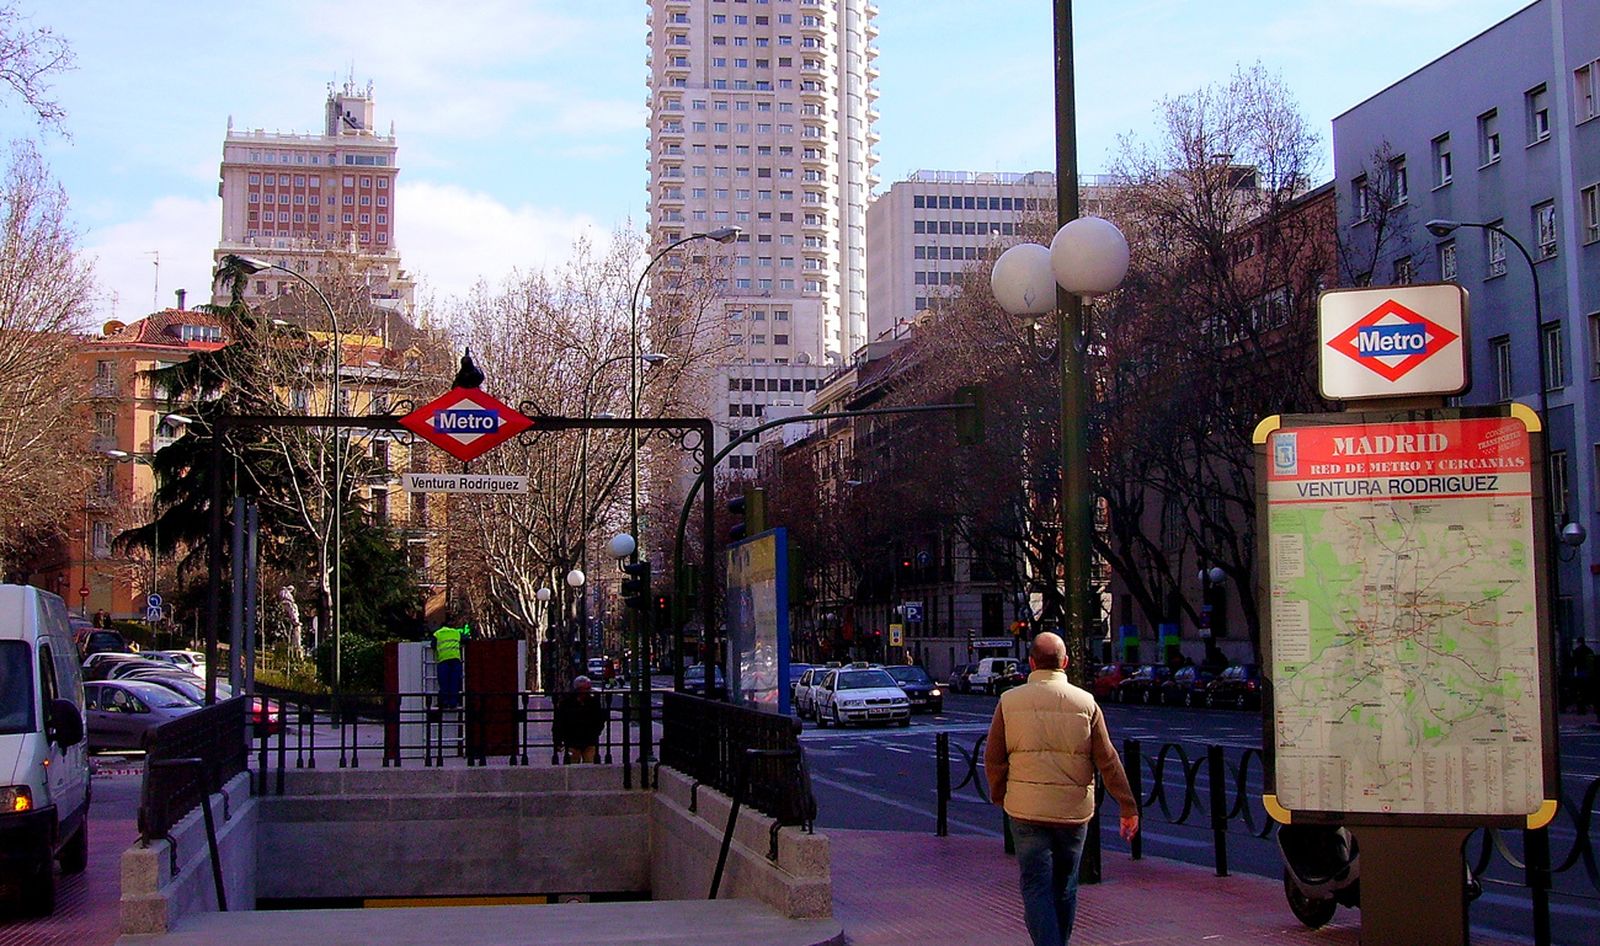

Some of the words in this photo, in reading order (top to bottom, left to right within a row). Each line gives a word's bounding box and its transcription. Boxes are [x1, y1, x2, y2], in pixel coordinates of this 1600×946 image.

[1358, 330, 1425, 352] Metro
[440, 412, 494, 429] Metro
[1332, 433, 1448, 456] MADRID
[1310, 464, 1341, 475] RED
[1345, 463, 1365, 474] DE
[1369, 460, 1421, 472] METRO
[1425, 460, 1435, 470] Y
[411, 477, 456, 489] Ventura
[459, 477, 519, 492] Rodriguez
[1297, 480, 1382, 497] VENTURA
[1388, 476, 1499, 494] RODRIGUEZ
